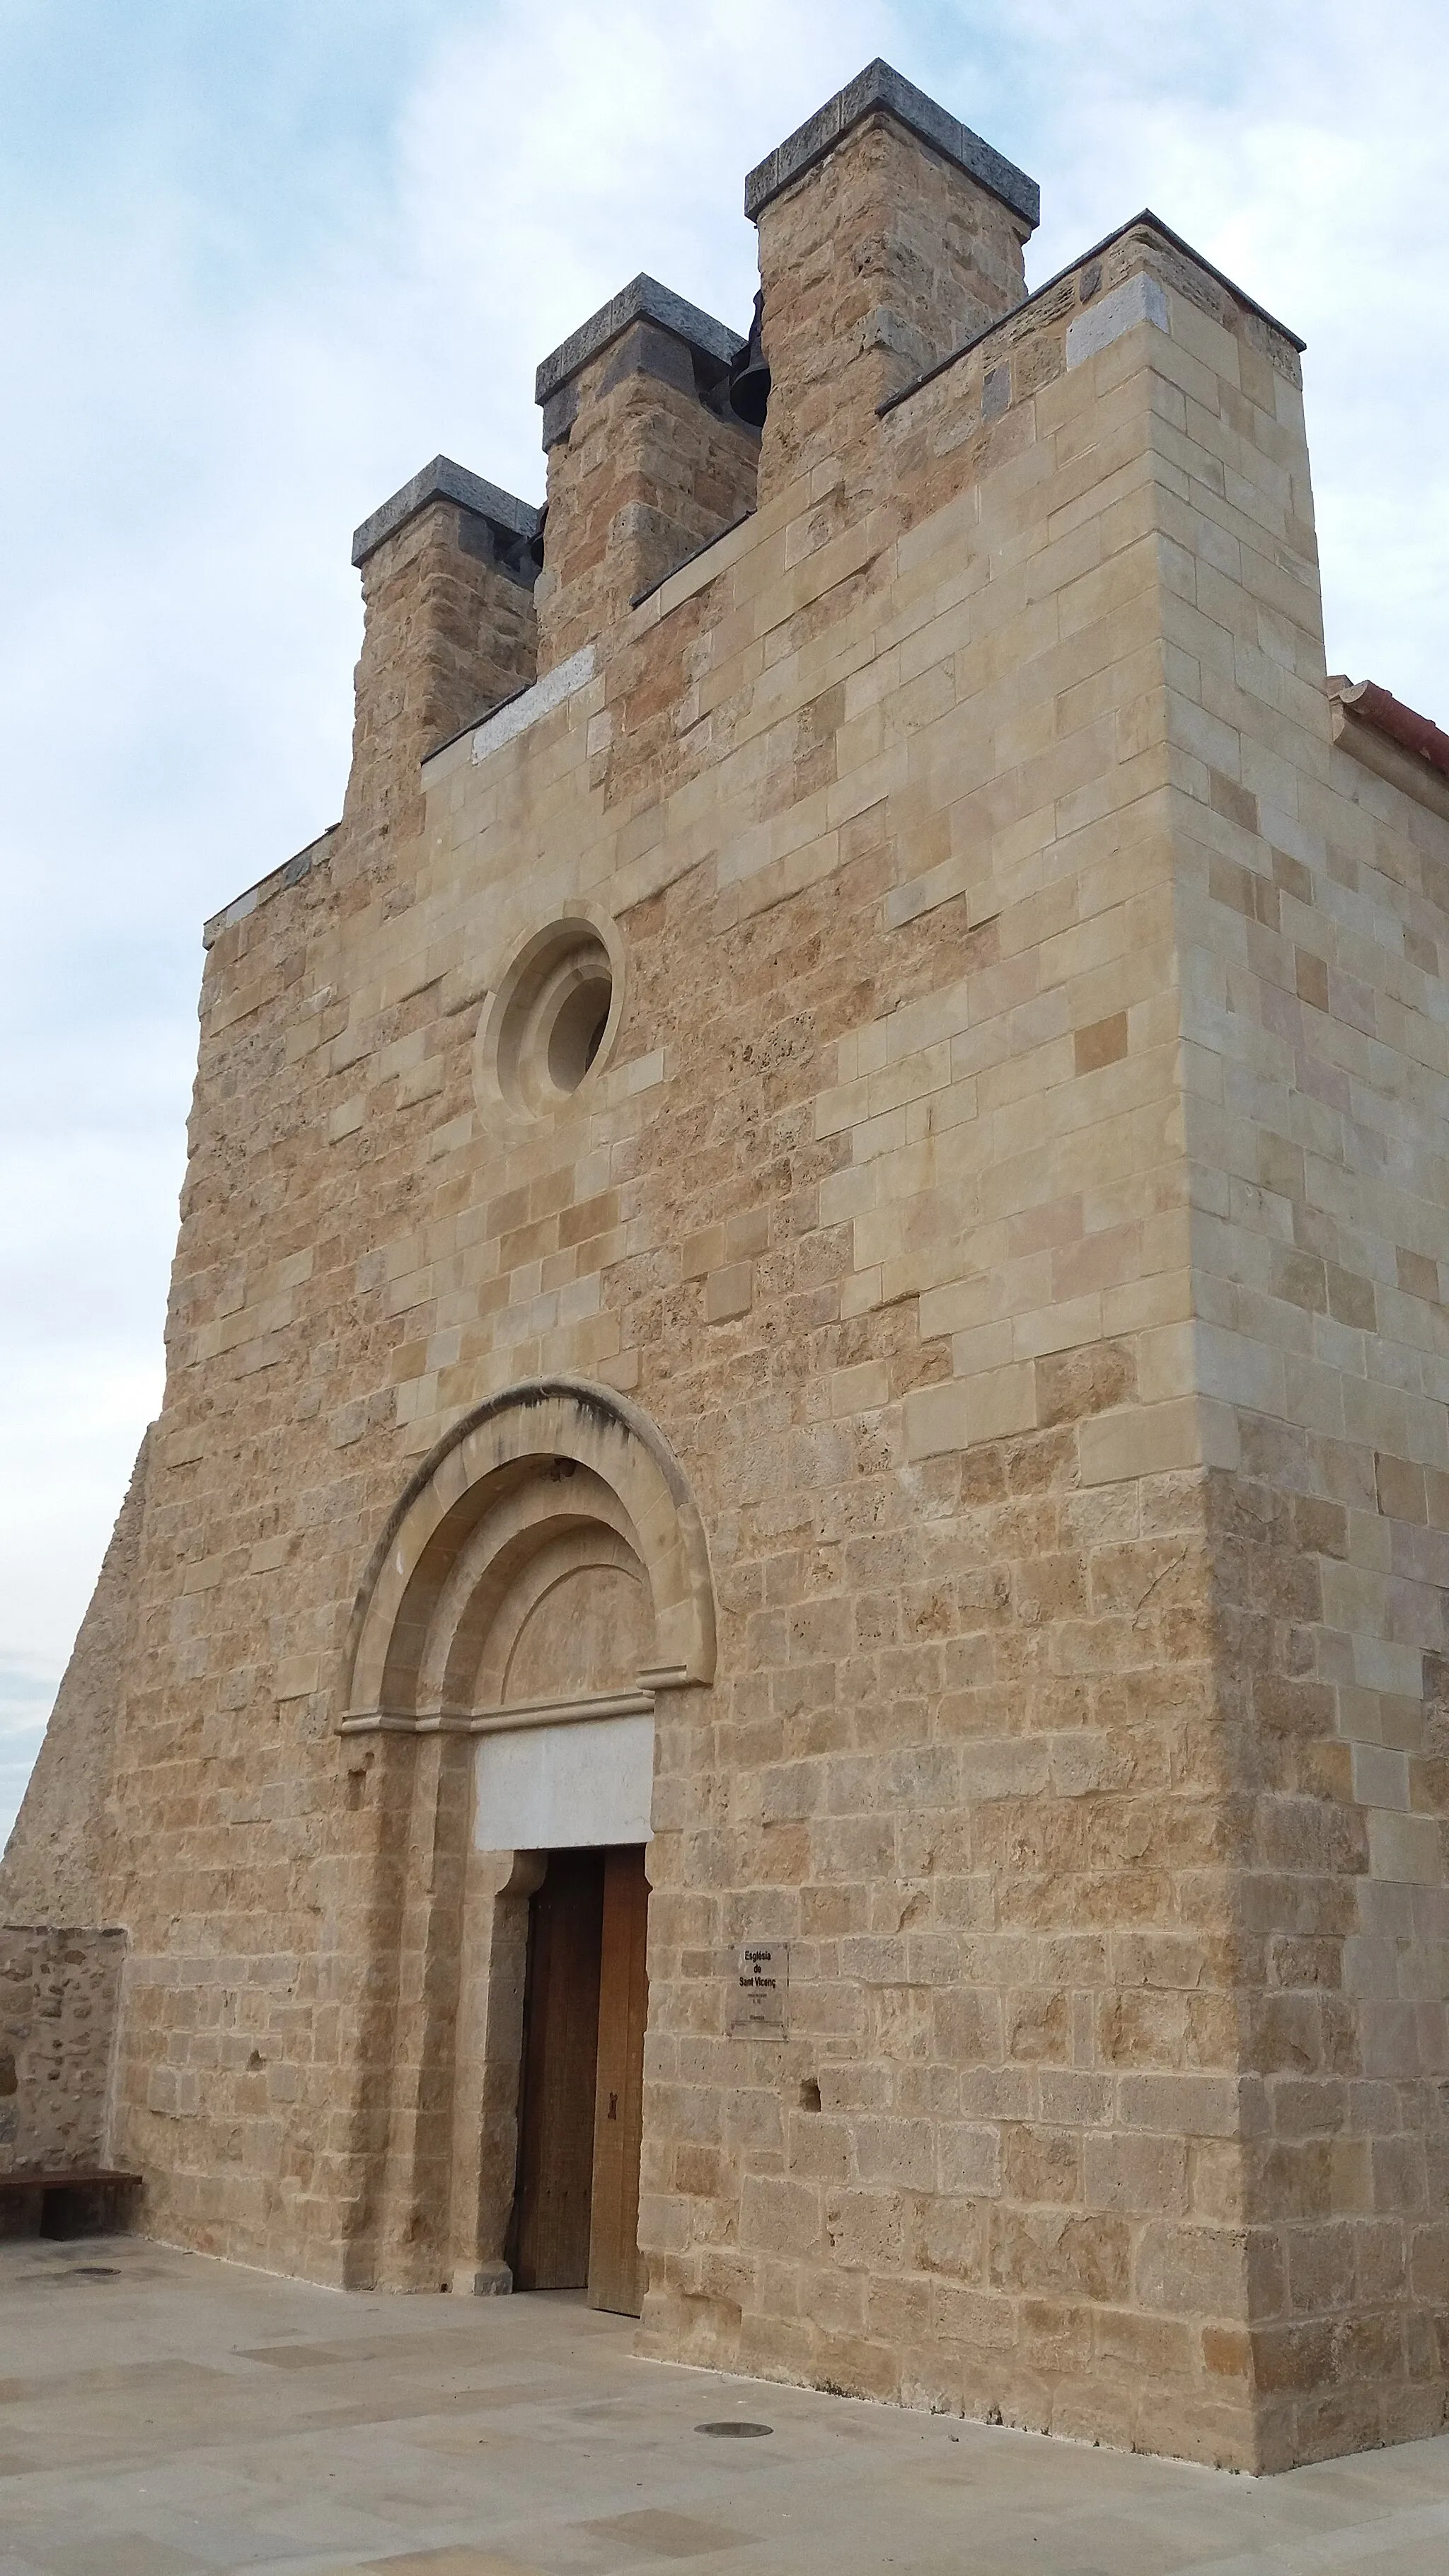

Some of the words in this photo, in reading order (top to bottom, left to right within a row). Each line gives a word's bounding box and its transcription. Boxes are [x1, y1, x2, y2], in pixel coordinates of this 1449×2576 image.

[744, 1951, 771, 1963] Església
[754, 1964, 761, 1973] de
[739, 1977, 754, 1987] Sant
[754, 1977, 776, 1989] Vicenç
